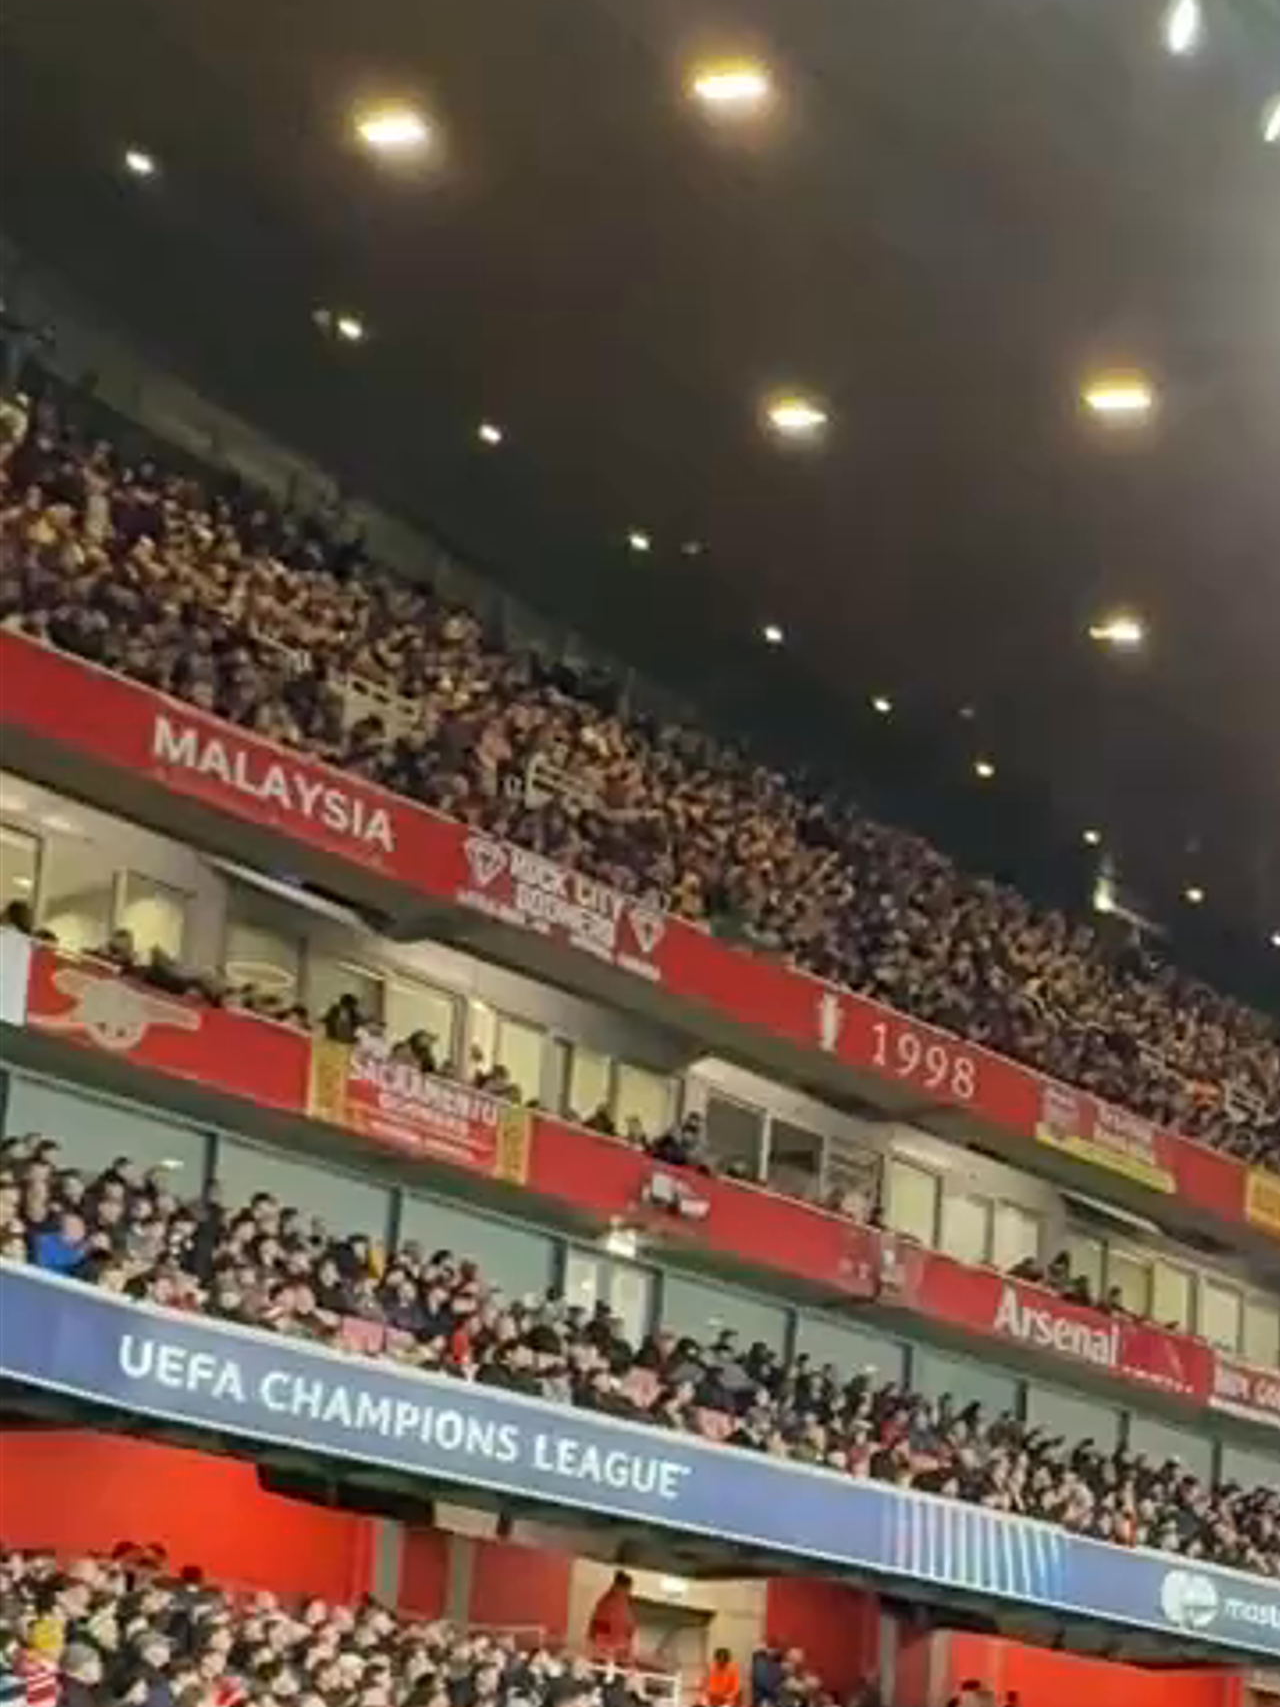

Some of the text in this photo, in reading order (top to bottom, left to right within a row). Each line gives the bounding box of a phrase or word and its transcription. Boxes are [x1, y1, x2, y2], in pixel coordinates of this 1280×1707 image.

[154, 715, 395, 852] MALAYSIA
[873, 1022, 974, 1099] 1998
[994, 1284, 1117, 1365] Arsenal
[118, 1334, 682, 1499] UEFA CHAMPIONS LEAGUE
